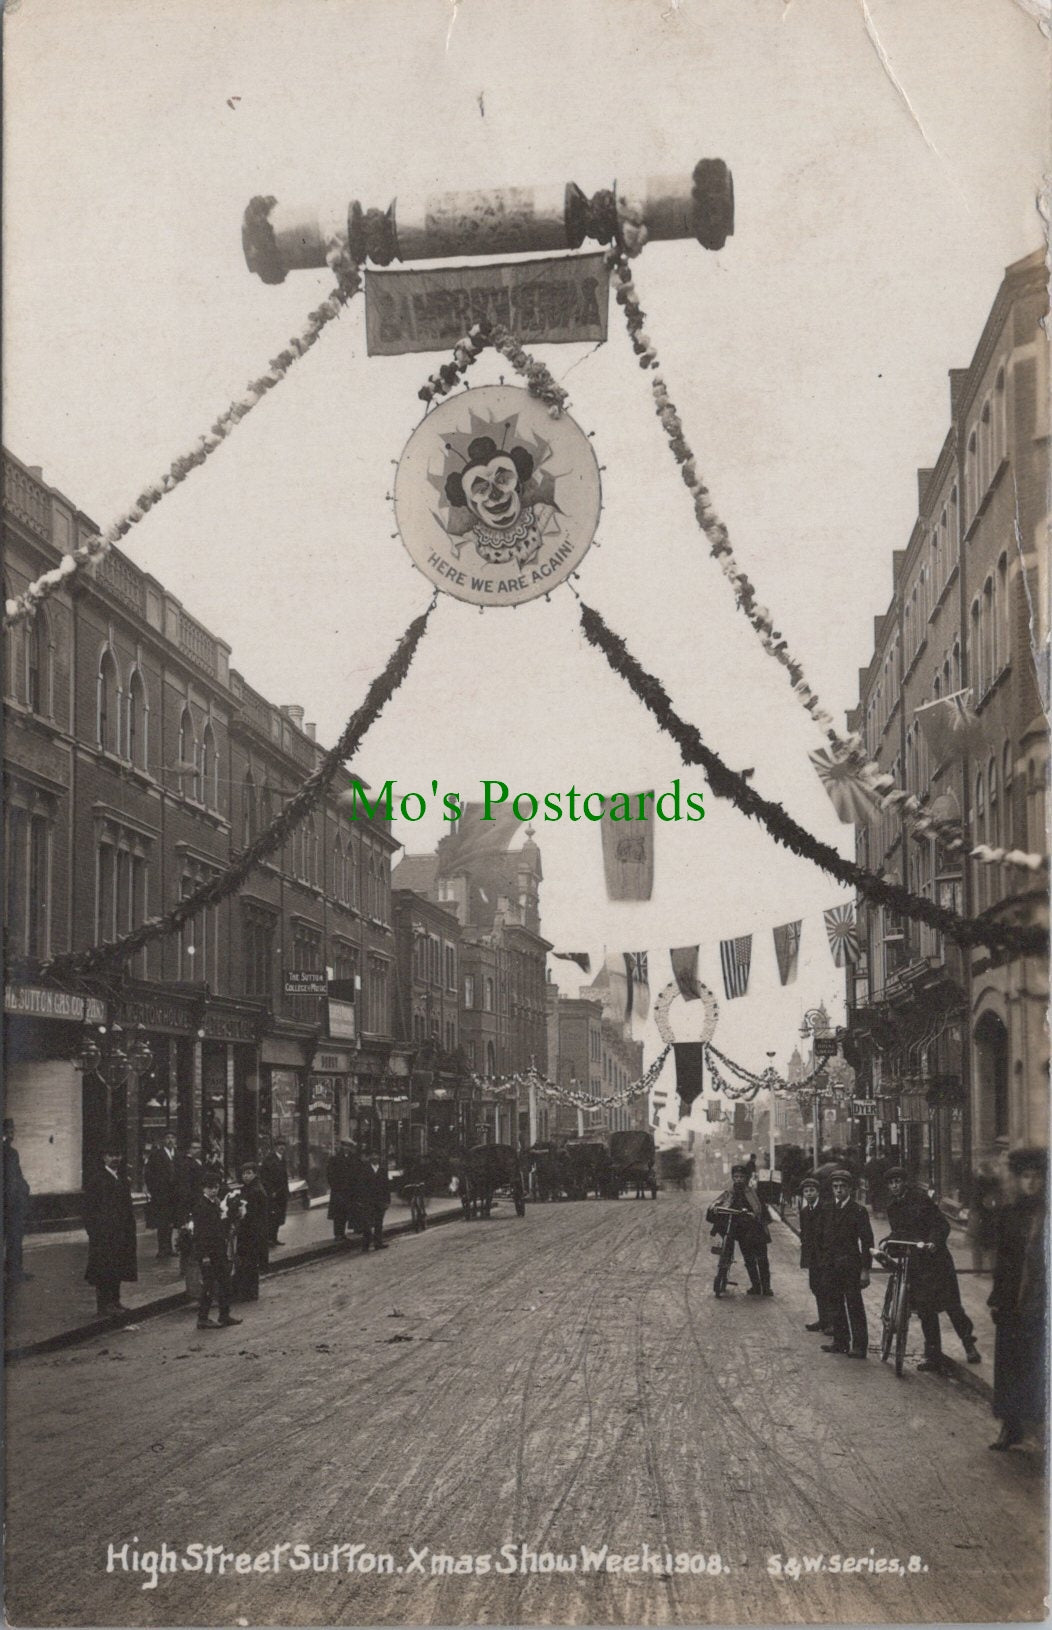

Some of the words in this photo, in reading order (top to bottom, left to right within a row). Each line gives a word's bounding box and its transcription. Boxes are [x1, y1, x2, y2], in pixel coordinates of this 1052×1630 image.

[471, 577, 494, 593] WE
[497, 575, 529, 593] ARE
[301, 972, 323, 982] SUTTON
[18, 988, 53, 1013] SUTTON
[54, 993, 70, 1015] GAS
